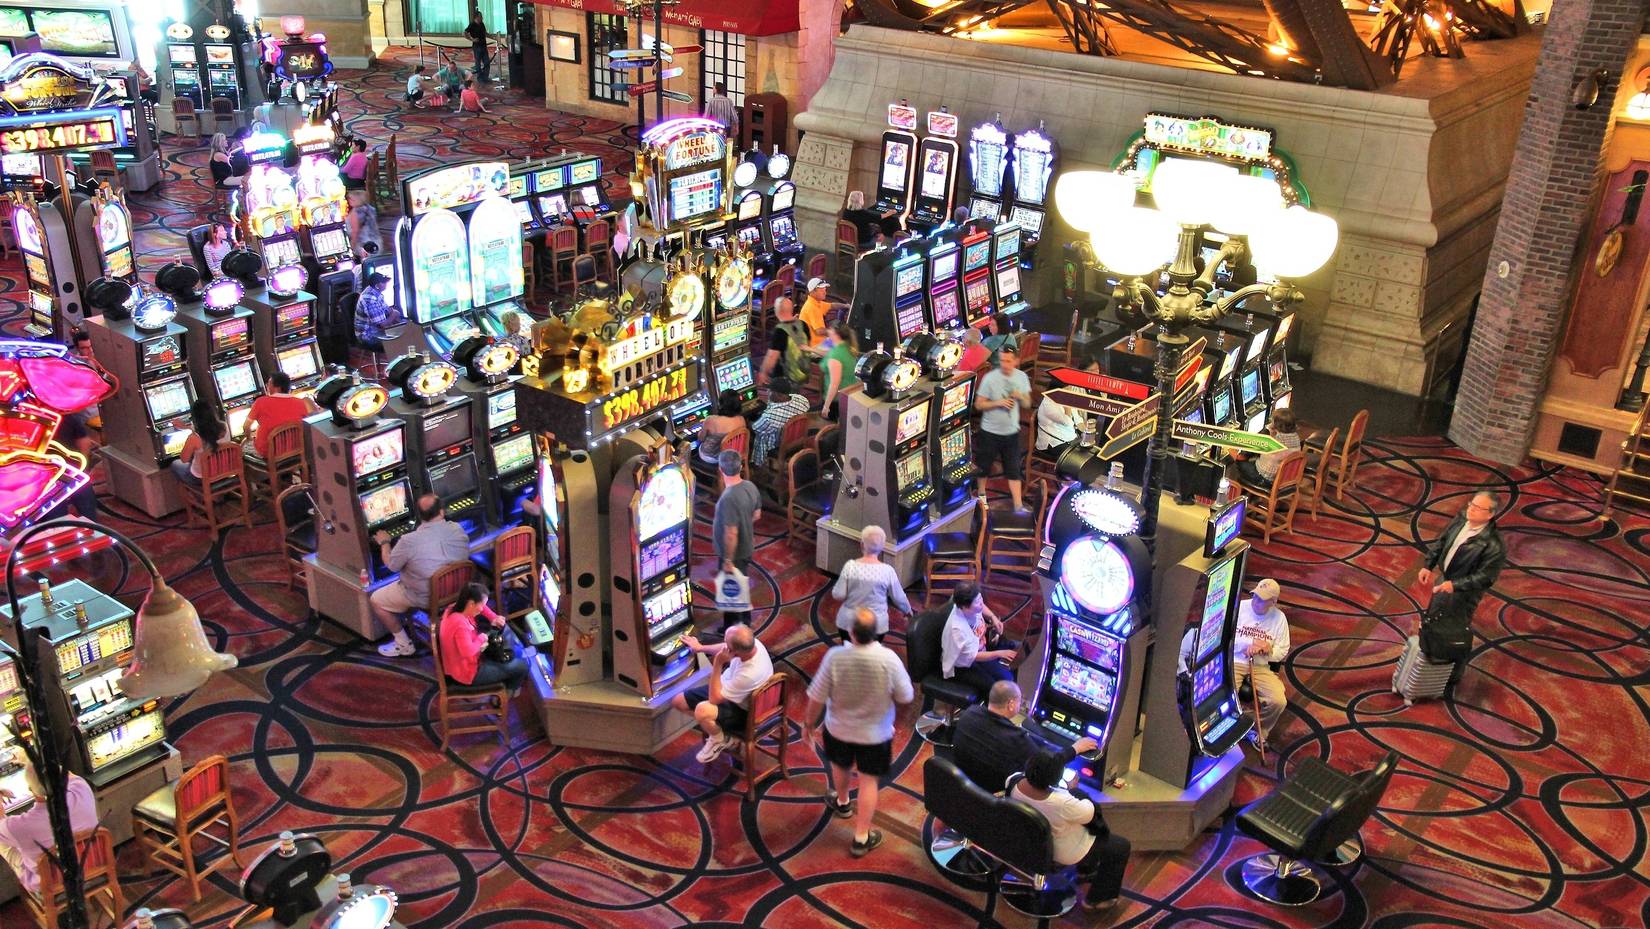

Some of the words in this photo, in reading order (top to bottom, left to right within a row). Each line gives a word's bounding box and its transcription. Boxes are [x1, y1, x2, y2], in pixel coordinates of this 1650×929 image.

[676, 137, 704, 149] WHEEL
[676, 144, 717, 160] FORTUNE
[610, 332, 660, 362] WHEEL
[614, 345, 685, 388] FORTUNE
[1088, 400, 1105, 411] Mon
[1106, 404, 1121, 413] Ami
[1176, 425, 1206, 438] Anthony
[1207, 429, 1228, 440] Cools
[1229, 434, 1269, 447] Experience
